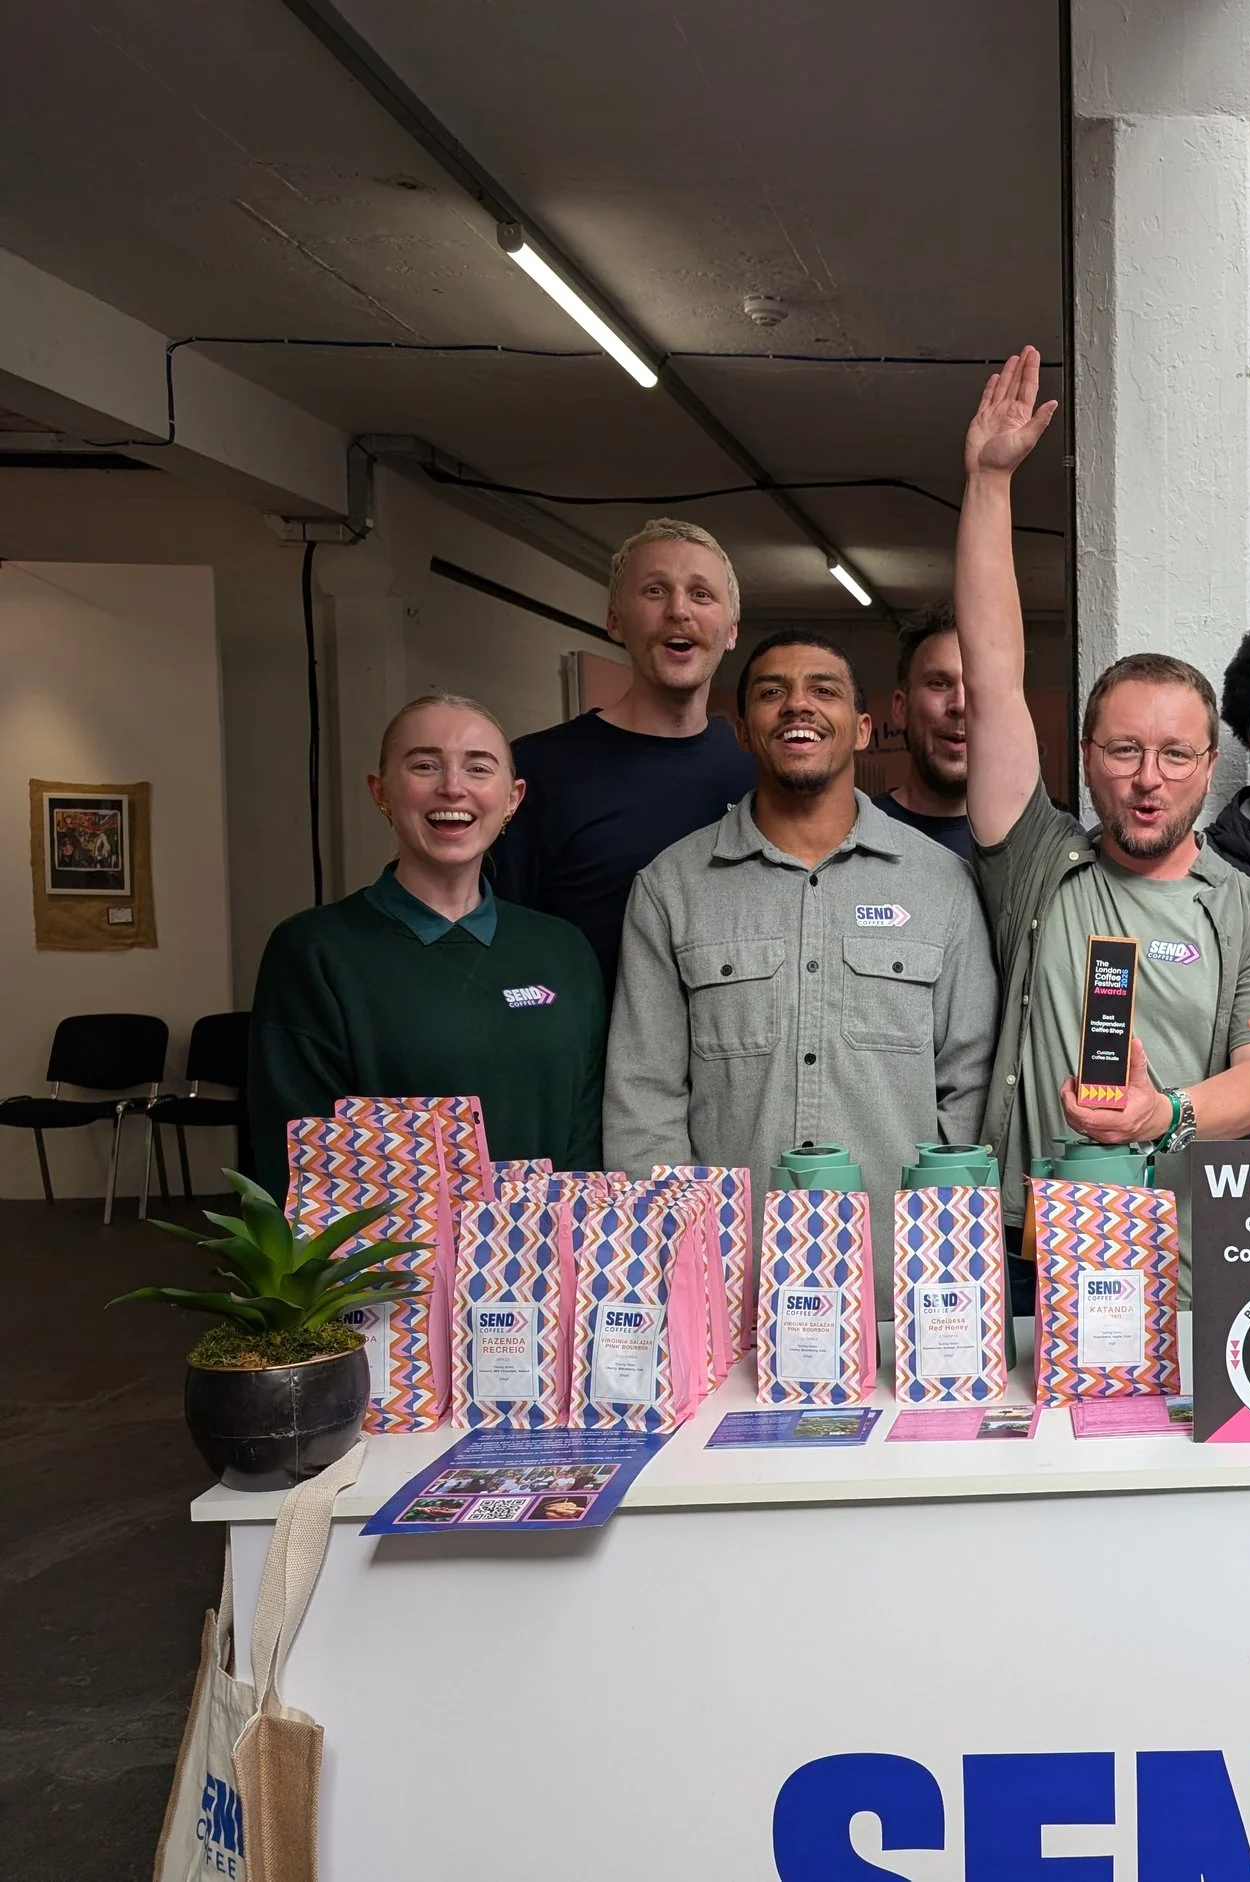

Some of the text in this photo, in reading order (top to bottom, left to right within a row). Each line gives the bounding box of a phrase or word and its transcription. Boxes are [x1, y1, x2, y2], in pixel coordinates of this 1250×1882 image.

[857, 907, 893, 920] SEND
[1150, 940, 1186, 958] SEND
[1148, 952, 1173, 961] COFFEE
[1096, 966, 1122, 974] London
[1095, 972, 1122, 982] Coffee
[1094, 980, 1121, 988] Festival
[503, 986, 542, 1002] SEND
[1094, 987, 1127, 996] Awards
[508, 1000, 536, 1008] COFFEE
[1090, 1020, 1126, 1028] Independent
[1088, 1281, 1122, 1294] SEND
[786, 1296, 822, 1310] SEND
[480, 1312, 514, 1327] SEND
[606, 1311, 644, 1328] SEND
[604, 1326, 632, 1334] COFFEE
[483, 1346, 525, 1354] RECREIO
